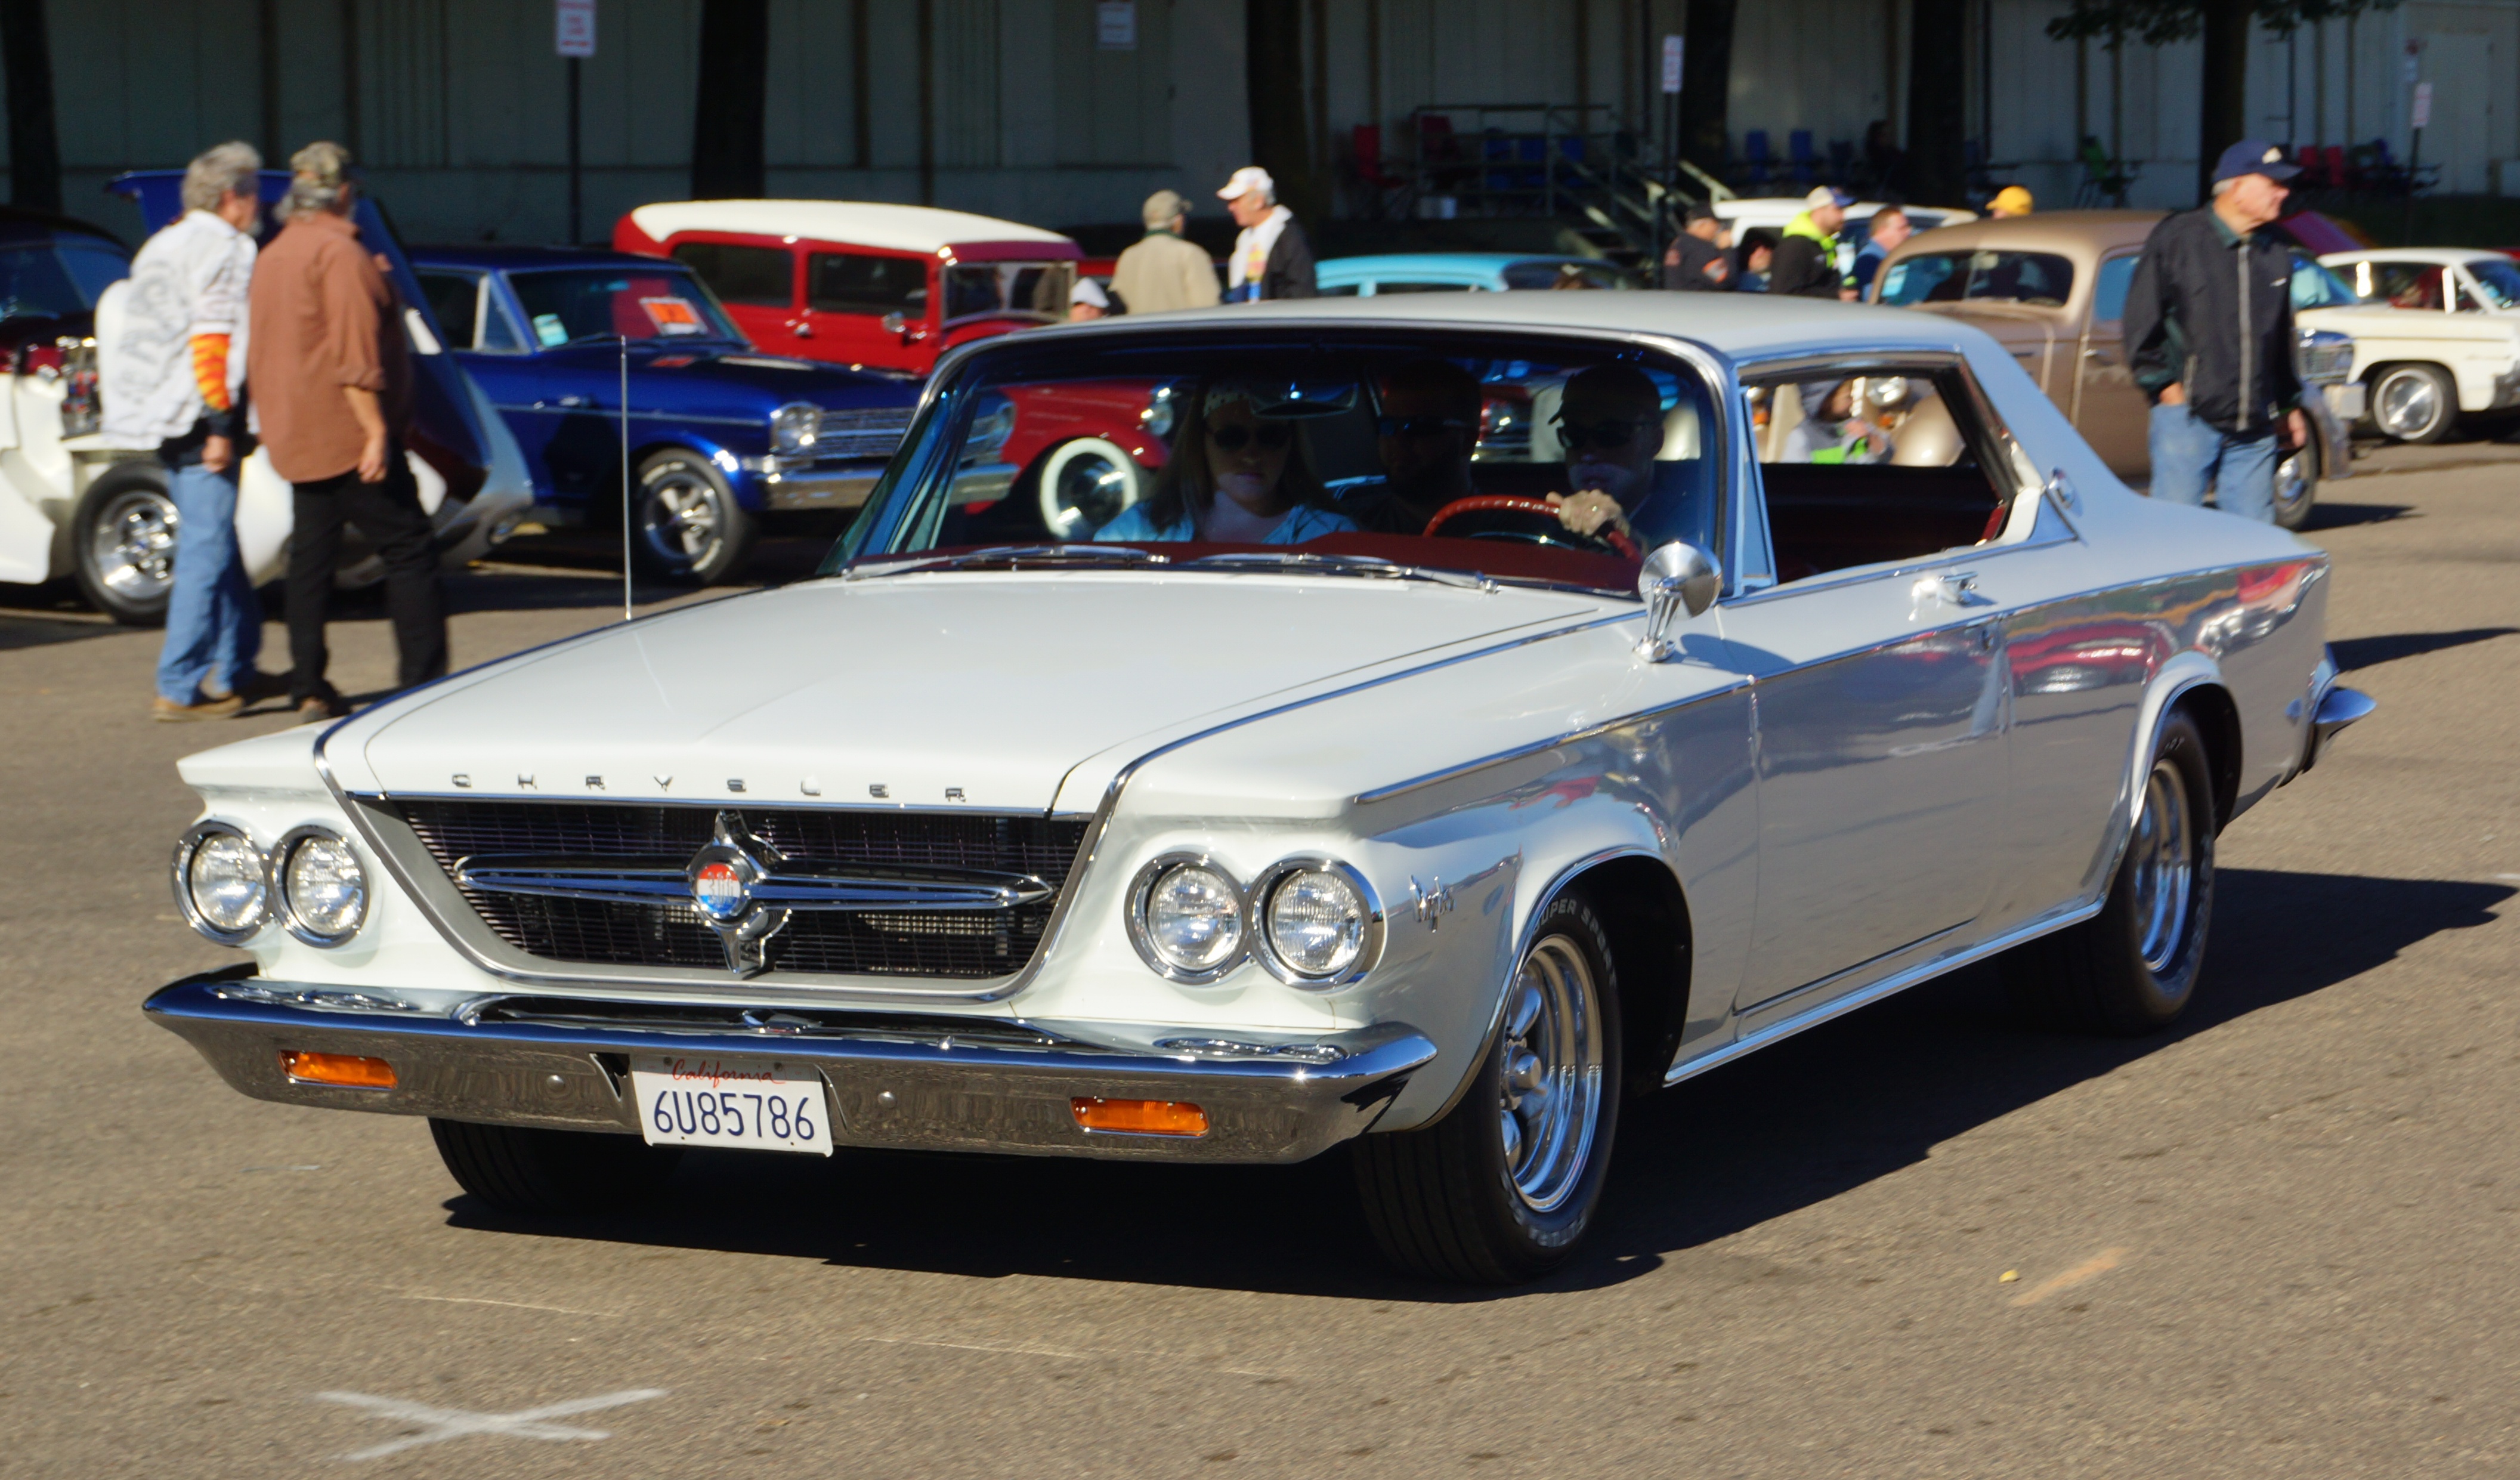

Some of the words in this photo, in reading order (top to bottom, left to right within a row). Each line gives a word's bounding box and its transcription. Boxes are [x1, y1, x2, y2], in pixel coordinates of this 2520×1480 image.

[452, 773, 966, 802] CHRYSLER
[672, 1058, 787, 1088] California
[654, 1090, 815, 1141] 6U85786
